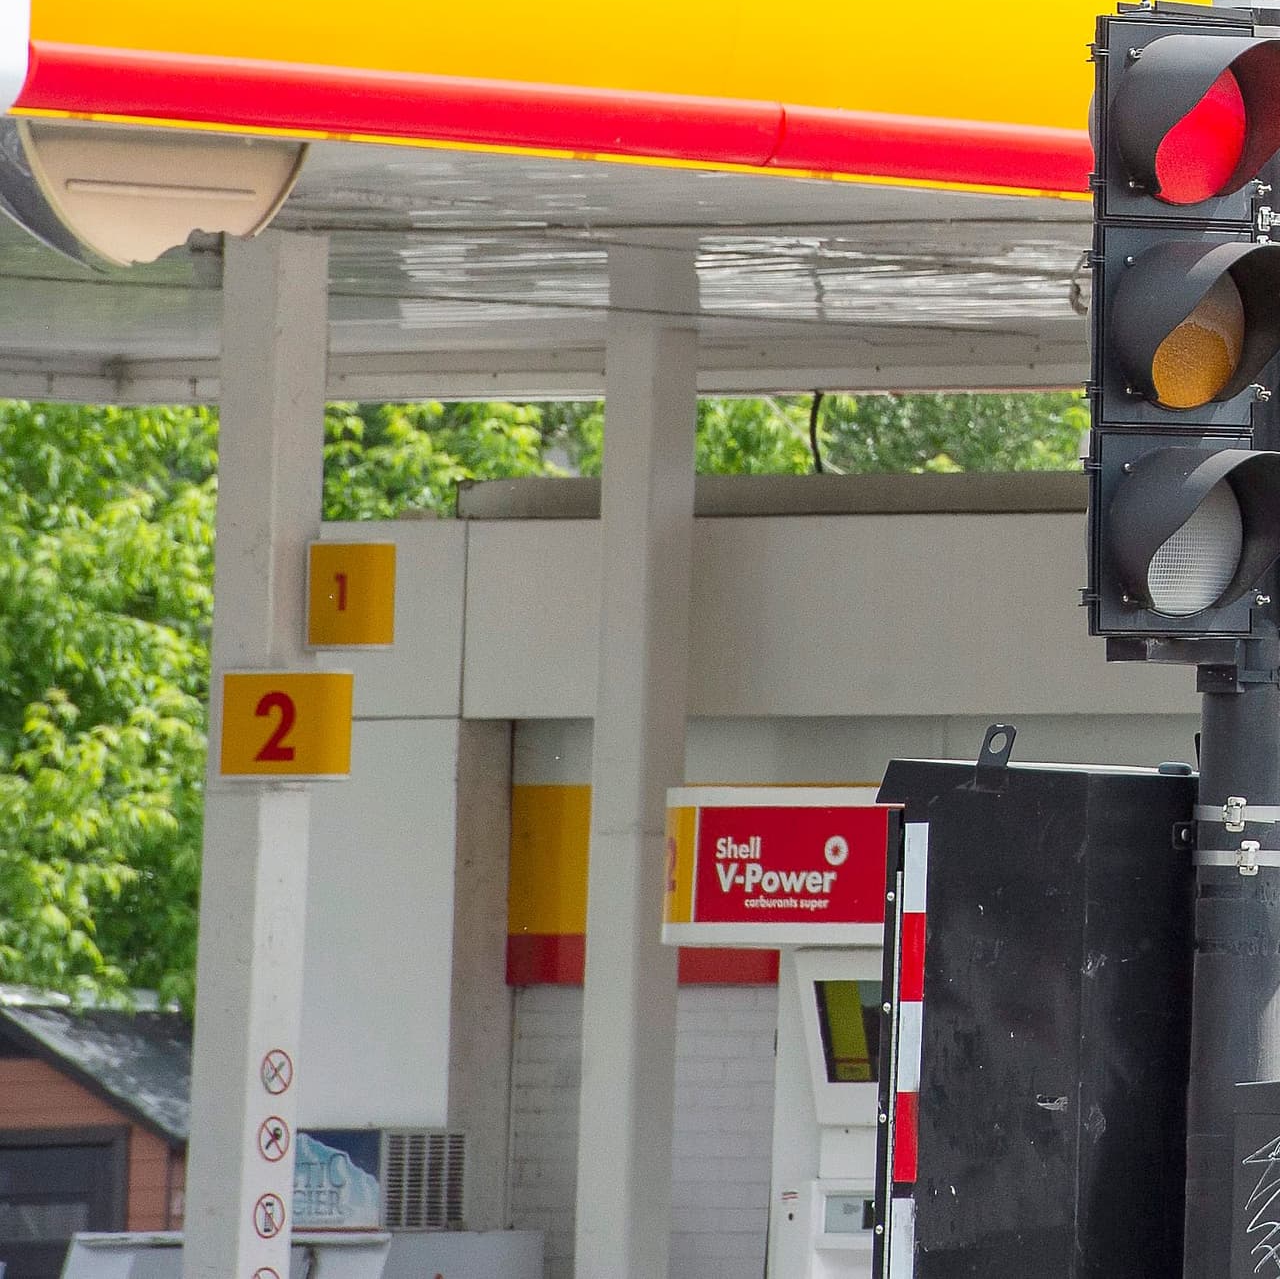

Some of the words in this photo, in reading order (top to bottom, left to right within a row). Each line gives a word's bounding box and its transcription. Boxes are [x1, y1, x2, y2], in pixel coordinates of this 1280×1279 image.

[335, 572, 348, 611] 1
[253, 691, 297, 762] 2
[715, 835, 761, 860] Shell
[715, 862, 838, 894] V-Power
[744, 894, 798, 909] carburants
[799, 898, 830, 912] super
